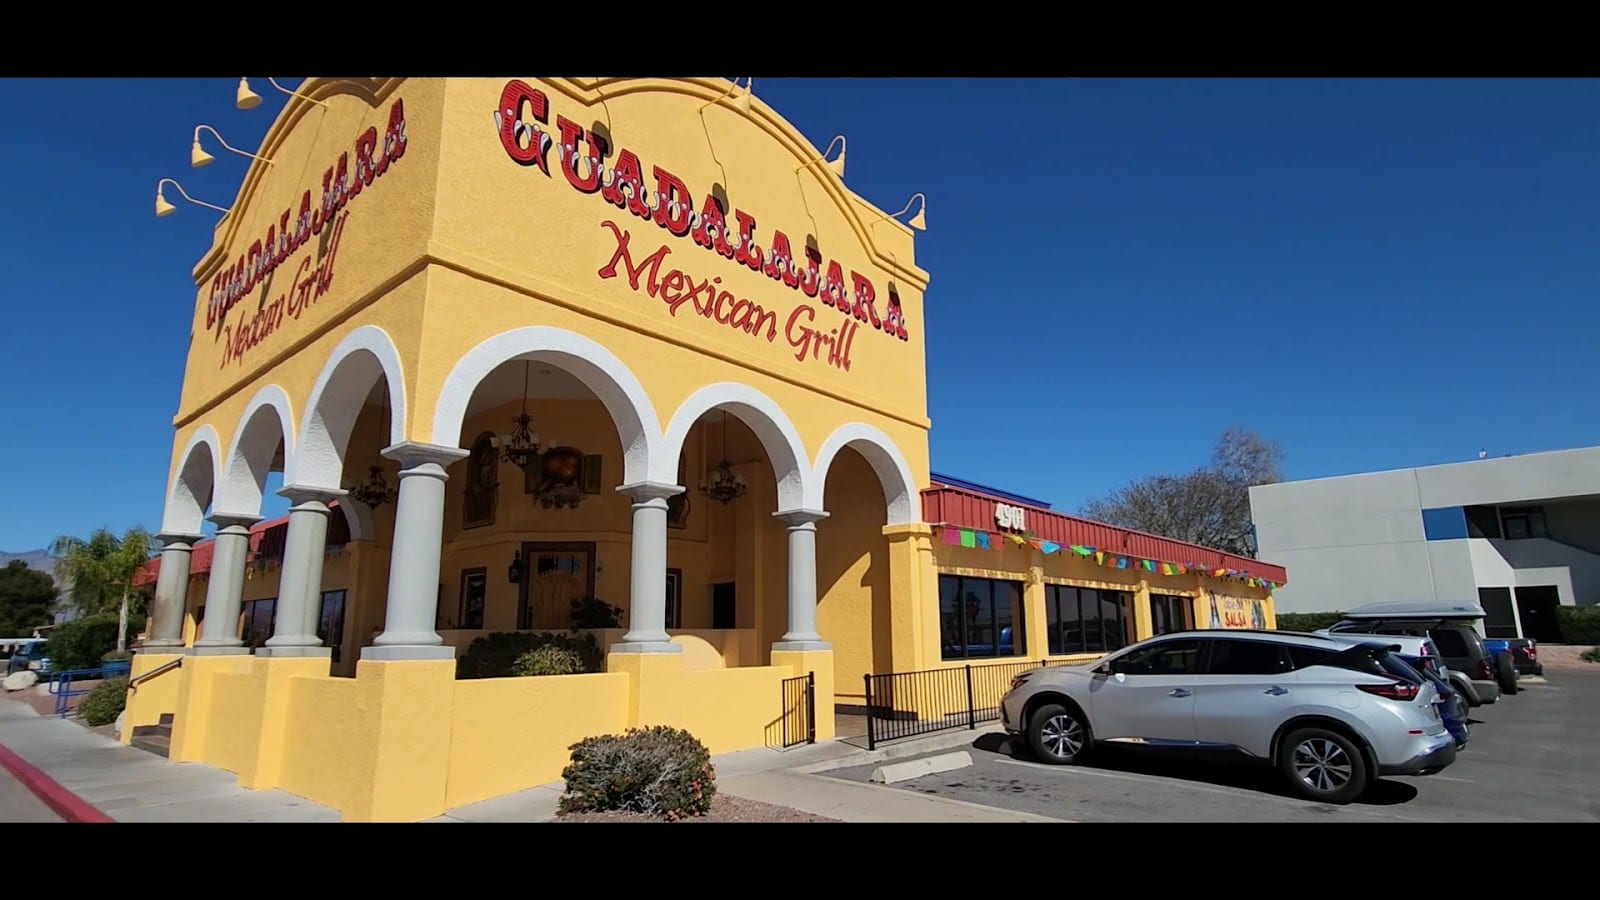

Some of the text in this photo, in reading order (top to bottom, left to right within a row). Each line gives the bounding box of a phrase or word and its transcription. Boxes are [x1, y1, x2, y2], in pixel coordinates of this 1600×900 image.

[206, 97, 408, 331] GUADALAJARA
[220, 209, 349, 371] Mexican Grill
[494, 79, 909, 342] GUADALAJARA
[598, 220, 861, 372] Mexican Grill
[1224, 611, 1248, 628] SALSA
